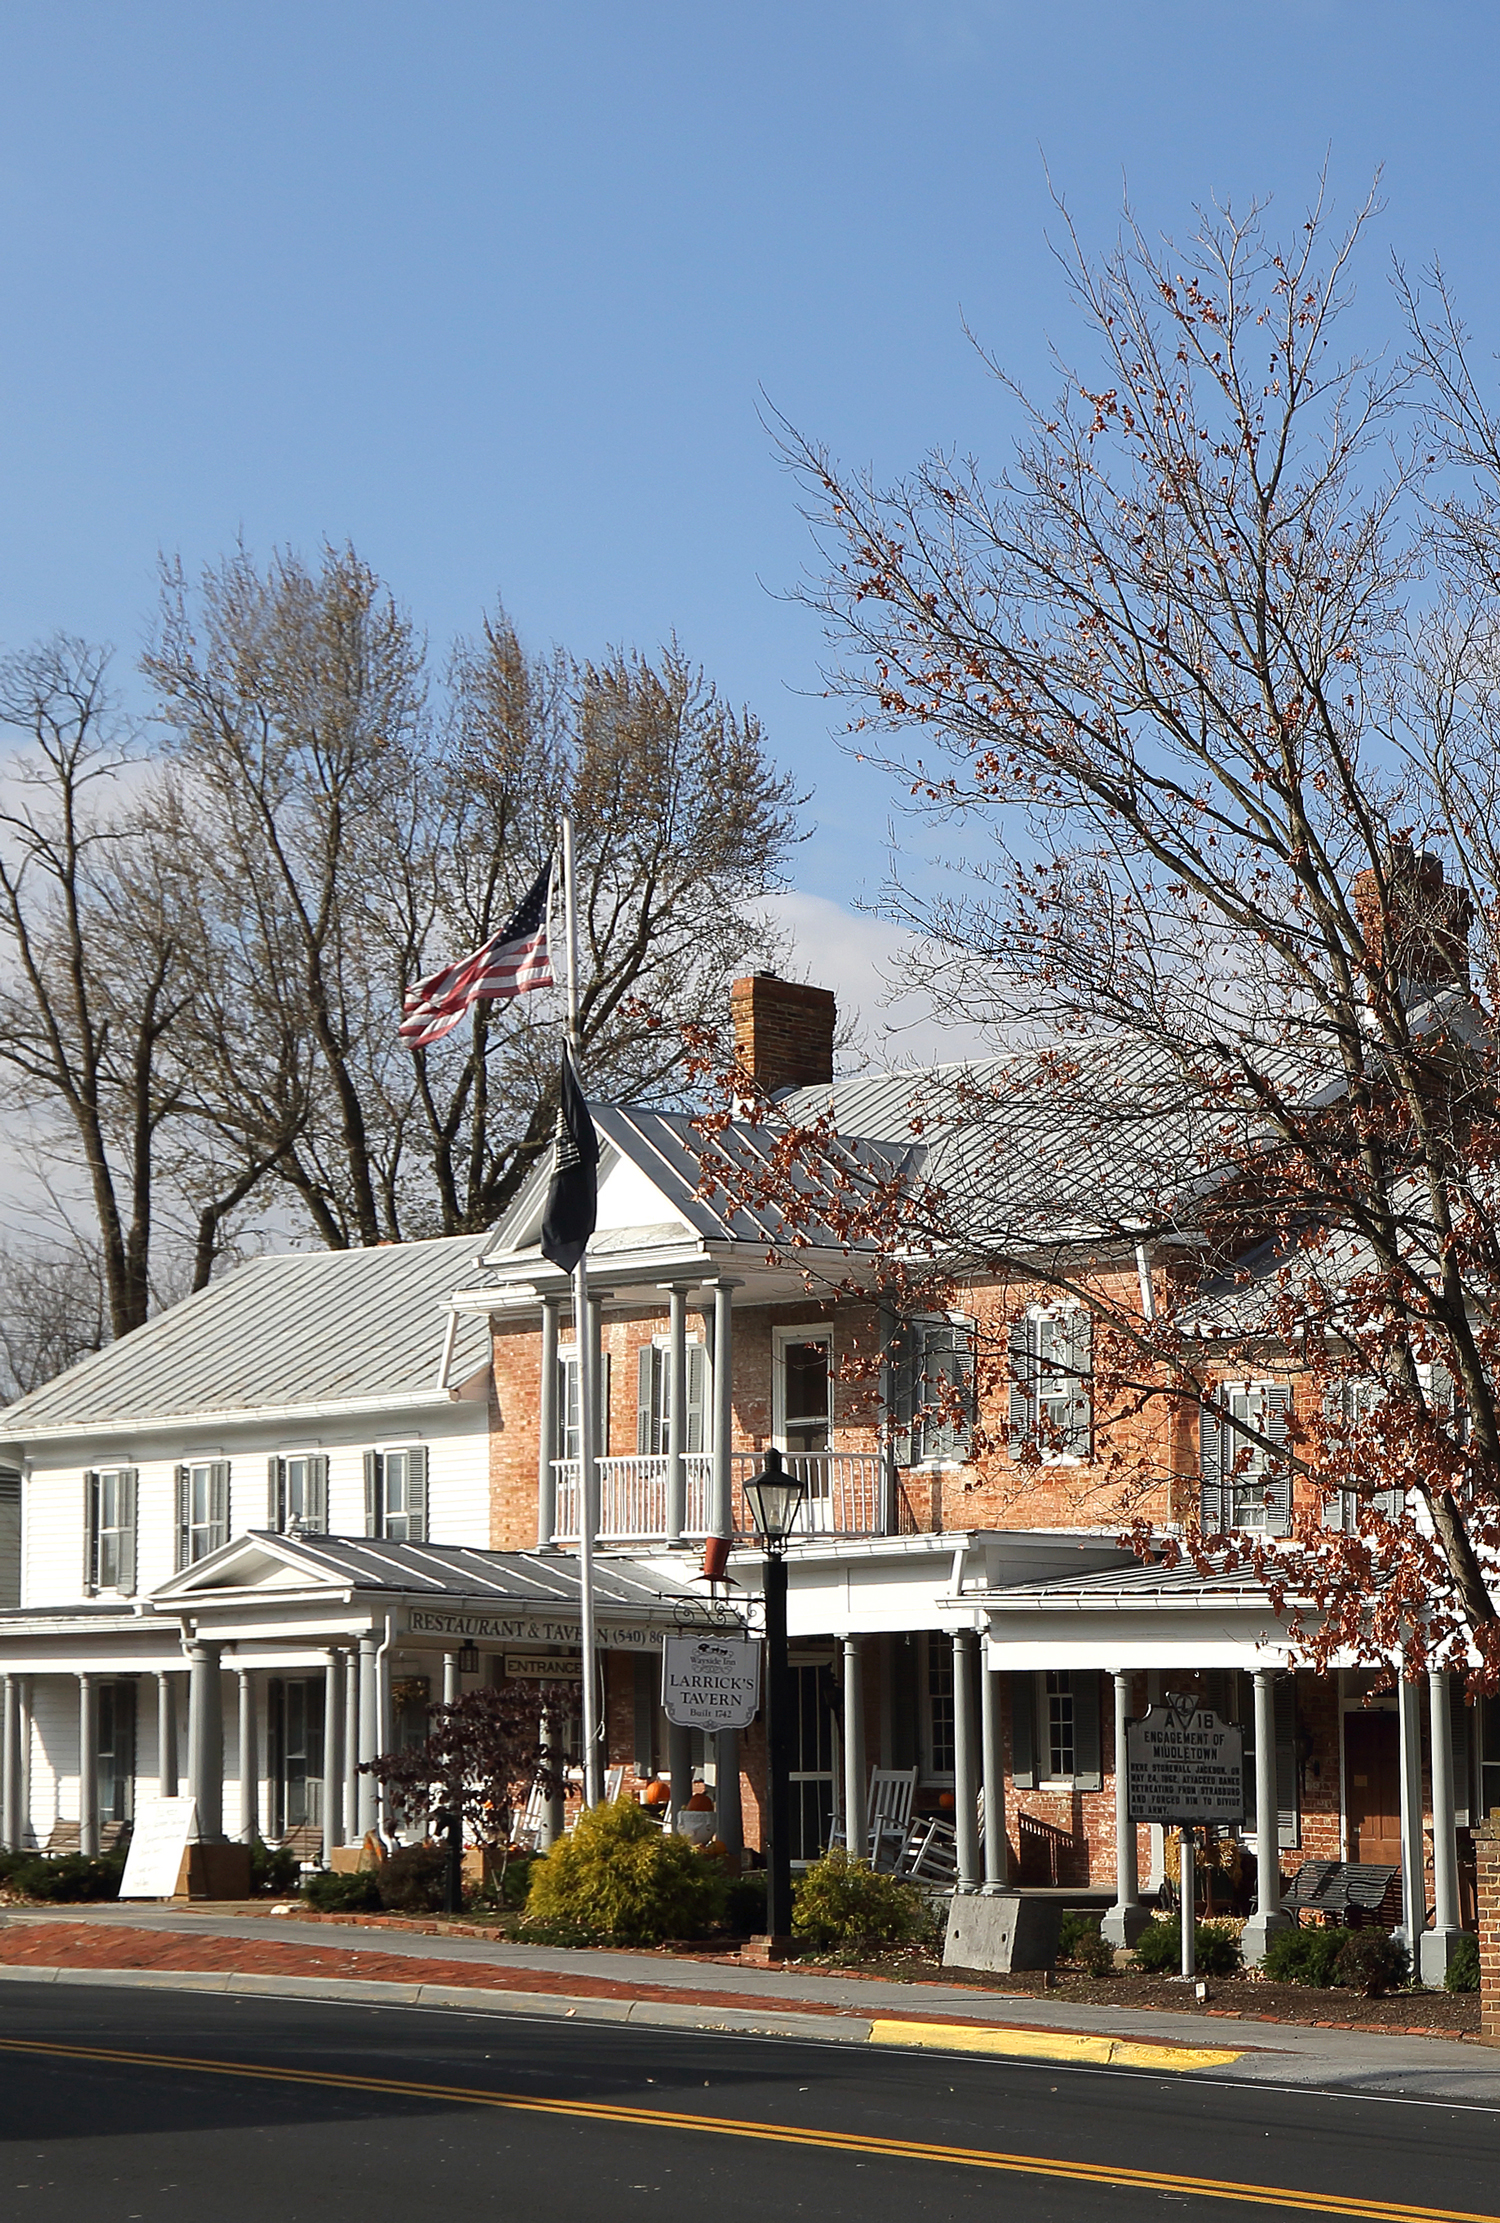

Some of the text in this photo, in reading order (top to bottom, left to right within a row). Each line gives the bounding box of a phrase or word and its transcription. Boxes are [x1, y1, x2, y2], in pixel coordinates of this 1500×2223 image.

[412, 1612, 524, 1637] RESTAURANT
[526, 1621, 540, 1638] &
[543, 1623, 608, 1643] TAVEN
[613, 1629, 645, 1645] (540)
[507, 1660, 583, 1674] ENTRANCE
[690, 1656, 721, 1666] Wayside
[670, 1674, 754, 1690] LARRICK'S
[680, 1691, 742, 1706] TAVERN
[690, 1708, 732, 1718] Built 1742
[1164, 1712, 1175, 1728] A
[1144, 1731, 1225, 1746] ENGAGEMENT OF
[1153, 1745, 1217, 1760] MIDDLETOWN
[1131, 1763, 1148, 1772] HERE
[1152, 1764, 1191, 1773] STONEWALL
[1131, 1773, 1144, 1782] MAY
[1182, 1776, 1216, 1785] ATTACKED
[1131, 1784, 1240, 1796] RETREATING FROM STRASBURG
[1132, 1795, 1146, 1803] AND
[1152, 1795, 1180, 1804] FORCED
[1185, 1797, 1198, 1805] HIM
[1203, 1797, 1212, 1805] TO
[1132, 1806, 1144, 1814] HIS
